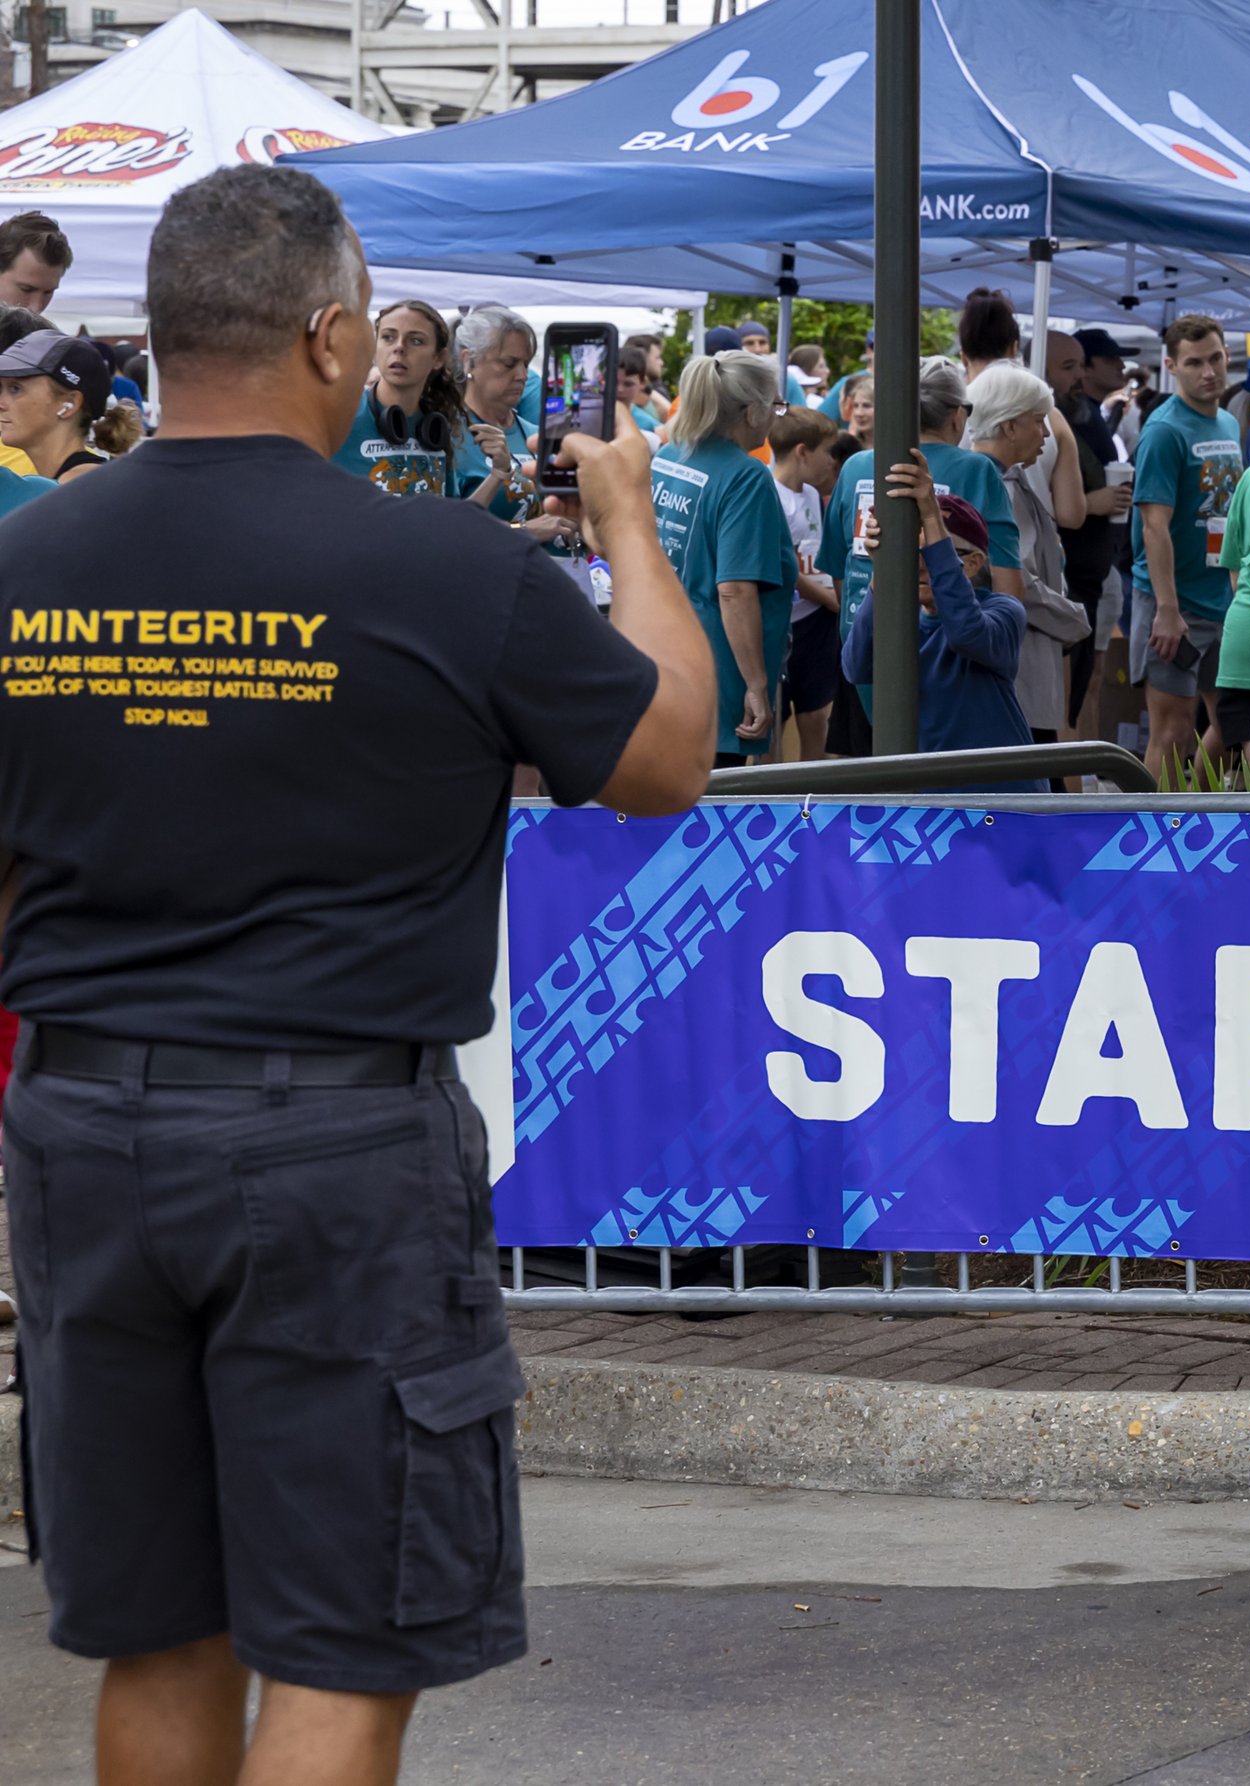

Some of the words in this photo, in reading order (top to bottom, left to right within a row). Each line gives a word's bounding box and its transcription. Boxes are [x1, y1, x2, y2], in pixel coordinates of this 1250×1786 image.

[619, 131, 791, 152] BANK
[919, 194, 1030, 220] ANK.com
[658, 489, 692, 515] BANK
[11, 608, 327, 648] MINTEGRITY
[13, 656, 46, 673] YOU
[47, 656, 82, 673] ARE
[84, 656, 123, 673] HERE
[182, 657, 214, 675] YOU
[216, 658, 256, 676] HAVE
[259, 658, 339, 680] SURVIVED
[58, 677, 85, 695] OF
[87, 678, 131, 696] YOUR
[134, 679, 211, 698] TOUGHEST
[124, 707, 165, 725] STOP
